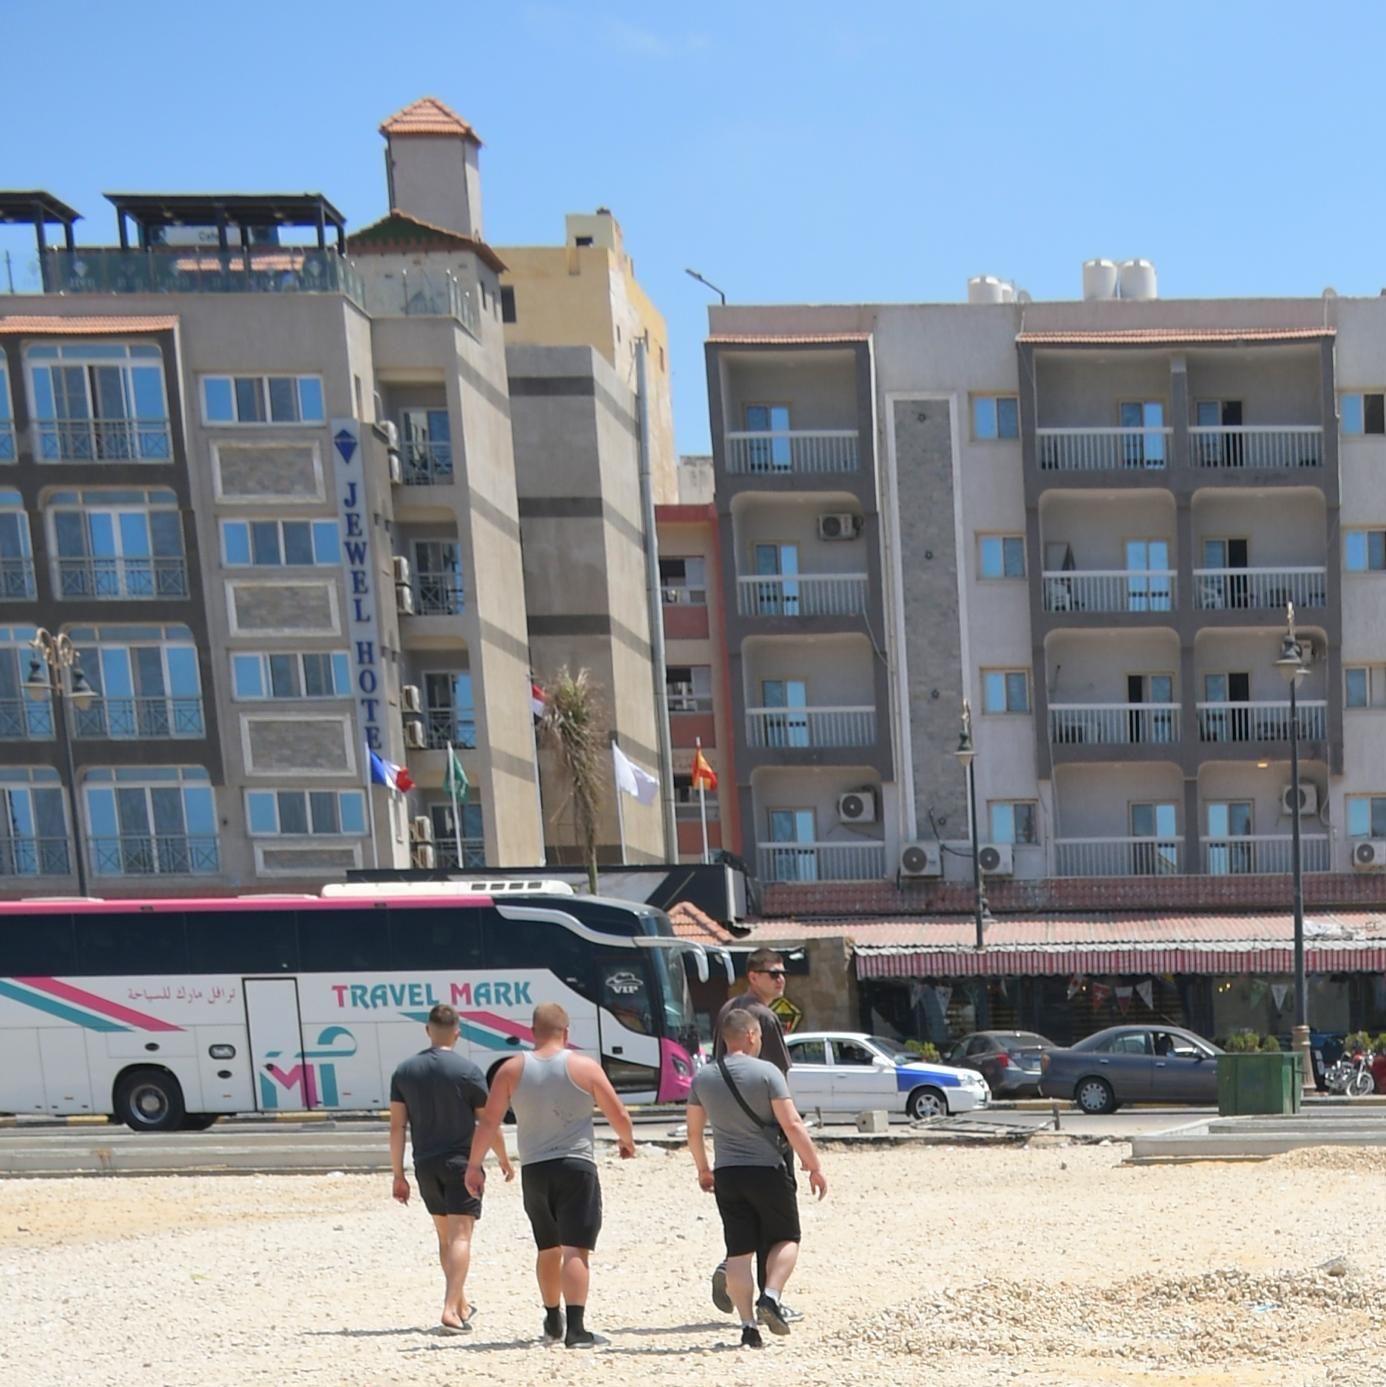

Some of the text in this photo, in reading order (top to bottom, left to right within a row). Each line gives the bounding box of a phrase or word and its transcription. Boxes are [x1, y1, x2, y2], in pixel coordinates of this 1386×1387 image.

[343, 482, 383, 751] JEWEL HOTE
[332, 981, 533, 1009] TRAVEL MARK
[611, 985, 639, 994] VIP
